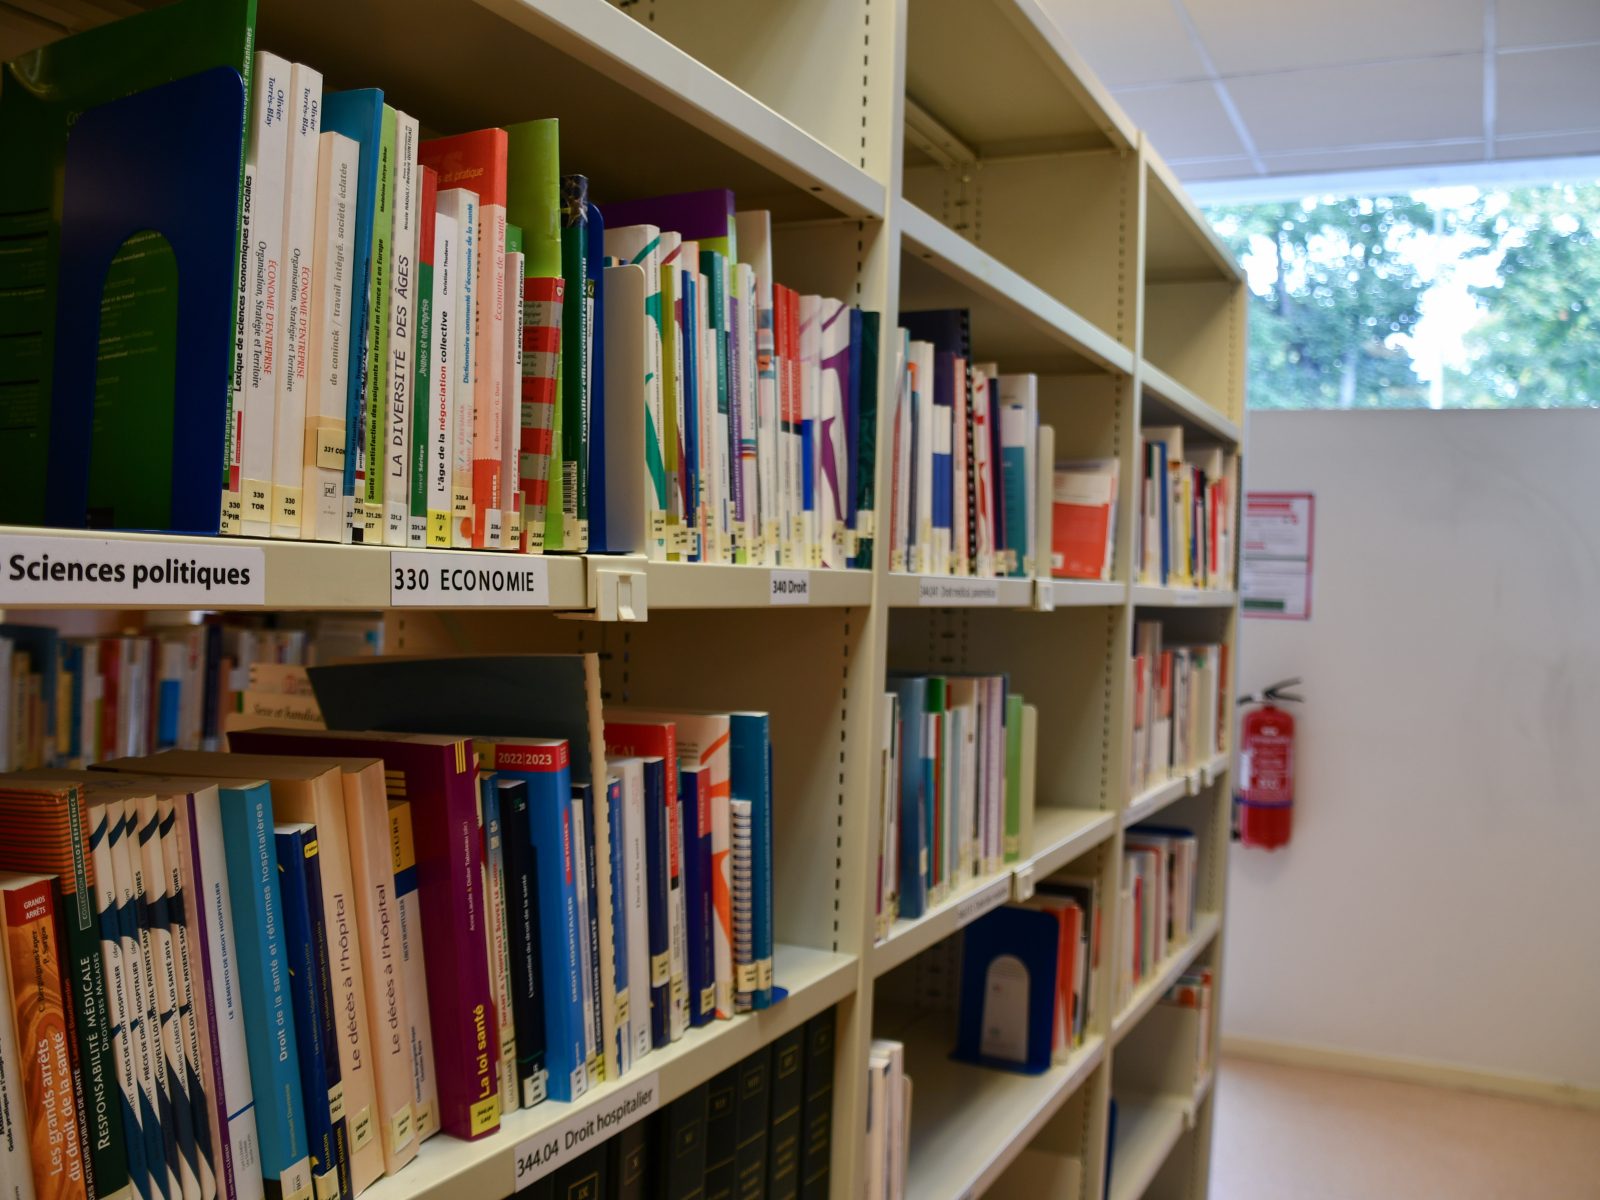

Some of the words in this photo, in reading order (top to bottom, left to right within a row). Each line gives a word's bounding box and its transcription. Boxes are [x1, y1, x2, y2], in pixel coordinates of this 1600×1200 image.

[265, 77, 275, 127] Torrès-Blay
[302, 87, 310, 136] Torrès-Blay
[310, 100, 318, 131] Olivier
[244, 175, 252, 213] sociales
[243, 214, 250, 226] et
[338, 202, 346, 240] société
[467, 226, 473, 235] la
[497, 215, 505, 241] santé
[376, 239, 384, 265] Europe
[467, 236, 473, 246] de
[496, 243, 504, 254] la
[239, 227, 249, 293] économiques
[254, 241, 267, 297] Organisation,
[495, 255, 504, 269] de
[290, 248, 301, 304] Organisation,
[394, 255, 409, 299] ÂGES
[237, 296, 245, 335] sciences
[333, 284, 342, 317] travail
[253, 299, 264, 337] Stratégie
[288, 306, 297, 342] Stratégie
[395, 305, 407, 338] DES
[421, 299, 430, 339] entreprise
[236, 337, 243, 350] de
[253, 340, 262, 349] et
[263, 313, 274, 376] D'ENTREPRISE
[288, 344, 295, 353] et
[297, 319, 308, 379] D'ENTREPRISE
[331, 330, 340, 369] coninck
[420, 340, 427, 348] et
[440, 311, 449, 363] collective
[233, 351, 243, 392] Lexique
[252, 353, 261, 389] Territoire
[373, 353, 379, 363] au
[419, 350, 427, 377] Jeunes
[462, 336, 470, 384] Dictionnaire
[286, 356, 294, 392] Territoire
[329, 373, 338, 385] de
[392, 349, 405, 446] DIVERSITÉ
[438, 366, 447, 431] négociation
[369, 420, 378, 466] satisfaction
[438, 433, 446, 443] la
[438, 446, 446, 460] de
[392, 454, 403, 478] LA
[437, 462, 446, 492] L'âge
[253, 491, 264, 499] 330
[367, 478, 376, 500] Santé
[9, 554, 126, 581] Sciences
[132, 558, 250, 590] politiques
[394, 568, 429, 591] 330
[441, 569, 534, 592] ECONOMIE
[773, 580, 787, 594] 340
[788, 580, 807, 594] Droit
[254, 802, 271, 882] hospitalières
[75, 844, 84, 875] DALLOZ
[23, 896, 46, 910] GRANDS
[25, 906, 46, 920] ARRÊTS
[214, 882, 224, 931] HOSPITALIER
[263, 886, 275, 940] réformes
[523, 908, 529, 920] de
[333, 894, 351, 972] l'hôpital
[376, 884, 392, 959] l'hôpital
[523, 921, 531, 942] droit
[567, 896, 577, 967] HOSPITALIER
[164, 941, 172, 959] 2016
[219, 933, 227, 957] DROIT
[268, 944, 277, 955] et
[525, 942, 531, 954] du
[92, 952, 104, 997] MALADES
[144, 955, 154, 988] PATIENTS
[165, 962, 175, 988] SANTÉ
[179, 950, 190, 982] PATIENTS
[222, 957, 229, 968] DE
[269, 958, 280, 993] santé
[382, 964, 393, 974] à
[79, 957, 97, 1027] MÉDICALE
[114, 965, 127, 1019] HOSPITALIER
[132, 961, 144, 1014] HOSPITALIER
[342, 976, 352, 987] à
[570, 969, 578, 1002] DROIT
[98, 1000, 106, 1013] DES
[169, 1002, 177, 1013] LA
[228, 1010, 234, 1020] LE
[273, 995, 282, 1008] la
[383, 979, 399, 1029] décès
[99, 1016, 110, 1051] DROITS
[119, 1020, 129, 1045] DROIT
[138, 1015, 147, 1039] DROIT
[151, 1023, 160, 1036] LOI
[187, 1018, 195, 1030] LOI
[274, 1010, 284, 1026] de
[344, 992, 359, 1044] décès
[472, 1003, 486, 1050] santé
[52, 1031, 68, 1076] santé
[122, 1047, 130, 1058] DE
[140, 1041, 148, 1052] DE
[153, 1037, 165, 1079] NOUVELLE
[188, 1031, 199, 1071] NOUVELLE
[277, 1029, 289, 1061] Droit
[351, 1046, 362, 1071] Le
[390, 1034, 401, 1054] Le
[37, 1038, 53, 1088] arrêts
[122, 1059, 134, 1087] PRÉCIS
[140, 1053, 150, 1081] PRÉCIS
[476, 1054, 488, 1075] loi
[59, 1078, 70, 1095] la
[86, 1032, 111, 1150] RESPONSABILITÉ
[479, 1077, 490, 1098] La
[42, 1089, 63, 1145] grands
[61, 1097, 73, 1117] de
[76, 1097, 84, 1109] DE
[64, 1118, 78, 1158] droit
[78, 1109, 89, 1146] PUBLICS
[517, 1138, 559, 1178] 344.04
[565, 1119, 594, 1150] Droit
[597, 1089, 653, 1131] hospitalier
[50, 1147, 63, 1177] Les
[68, 1160, 81, 1181] du
[81, 1146, 94, 1183] ACTEURS
